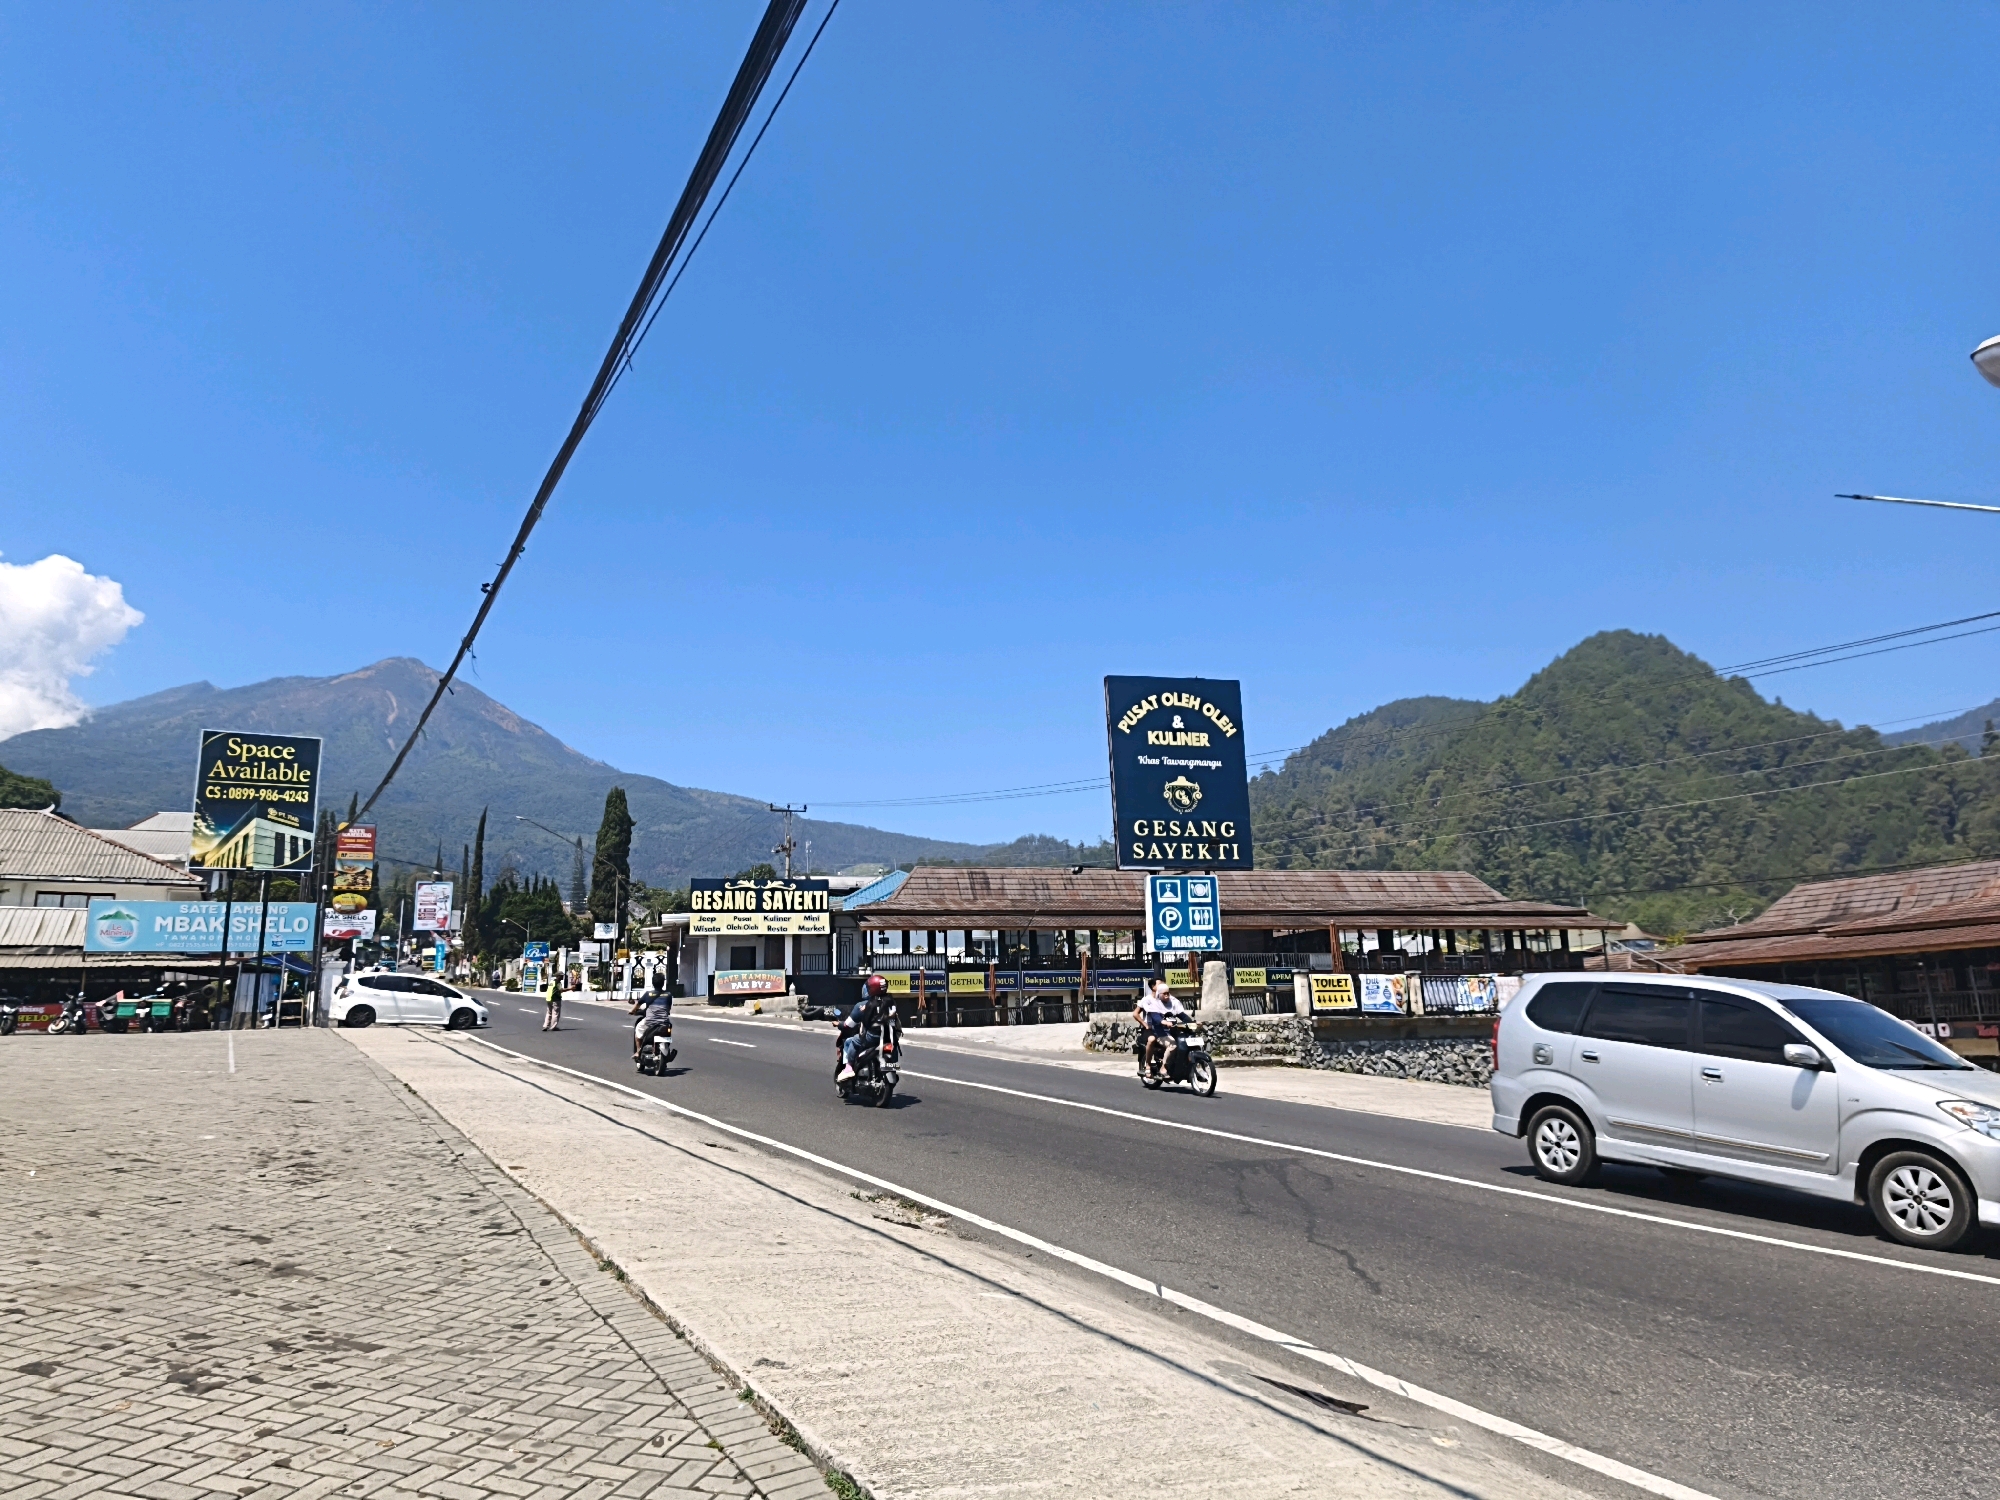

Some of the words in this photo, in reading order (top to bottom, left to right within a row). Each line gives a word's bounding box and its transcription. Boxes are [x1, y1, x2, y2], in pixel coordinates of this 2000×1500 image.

[1117, 694, 1159, 734] PUSAT
[1161, 691, 1201, 711] OLEH
[1202, 702, 1238, 738] OLEH
[1172, 714, 1185, 729] &
[1147, 730, 1211, 747] KULINER
[226, 737, 296, 763] Space
[1137, 754, 1161, 766] Khas
[1161, 755, 1223, 771] Tawangmangu
[207, 759, 311, 782] Available
[228, 786, 309, 803] 0899-986-4243
[1133, 819, 1236, 838] GESANG
[1132, 842, 1240, 860] SAYEKTI
[691, 890, 757, 911] GESANG
[762, 890, 828, 911] SAYEKTI
[179, 904, 219, 914] SATE
[222, 905, 289, 915] AMBNG
[154, 916, 225, 933] MBAK
[231, 916, 310, 934] SHELO
[697, 915, 717, 924] Jeep
[763, 914, 792, 922] Kuliner
[797, 924, 826, 932] Market
[1171, 935, 1208, 948] MASUK
[717, 974, 740, 985] SATE
[741, 973, 783, 984] KAMBING
[730, 981, 750, 990] PAK
[751, 980, 764, 989] BY
[950, 978, 984, 986] GETHUK
[990, 977, 1015, 985] IMUS
[1025, 976, 1050, 985] Bakpia
[1313, 978, 1349, 988] TOILET
